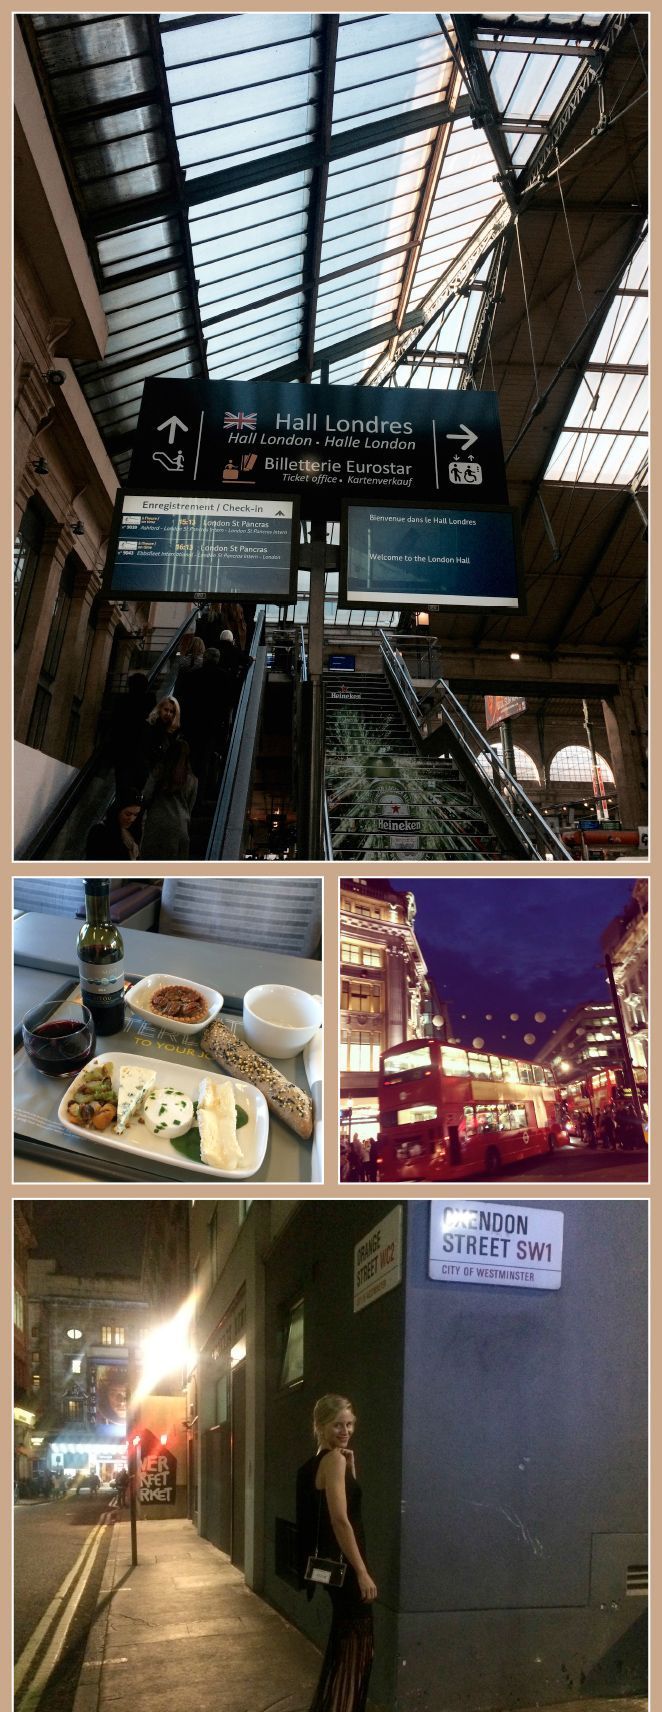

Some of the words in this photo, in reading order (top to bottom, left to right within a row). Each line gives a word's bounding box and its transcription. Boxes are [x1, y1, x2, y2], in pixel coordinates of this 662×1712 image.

[276, 413, 317, 431] Hall
[326, 415, 413, 435] Londres
[228, 432, 256, 444] Hall
[260, 433, 312, 446] London
[324, 436, 360, 448] Halle
[364, 437, 416, 450] London
[264, 457, 342, 472] Billetterie
[346, 460, 412, 475] Eurostar
[283, 474, 309, 482] Ticket
[311, 474, 338, 484] office
[347, 476, 413, 488] Kartenverkauf
[142, 500, 215, 512] Enregistrement
[222, 503, 264, 513] Check-in
[369, 514, 405, 523] Bienvenue
[449, 518, 477, 526] Londres
[378, 819, 420, 831] Heineken
[134, 1036, 151, 1047] TO
[155, 1041, 196, 1057] YOUR
[357, 1230, 381, 1266] ORANGE
[442, 1232, 511, 1258] STREET
[516, 1240, 552, 1262] SW1
[356, 1255, 378, 1288] STREET
[380, 1242, 395, 1270] WC2
[442, 1264, 460, 1275] CITY
[463, 1266, 474, 1276] OF
[476, 1268, 535, 1282] WESTMINSTER
[140, 1488, 172, 1502] RKET
